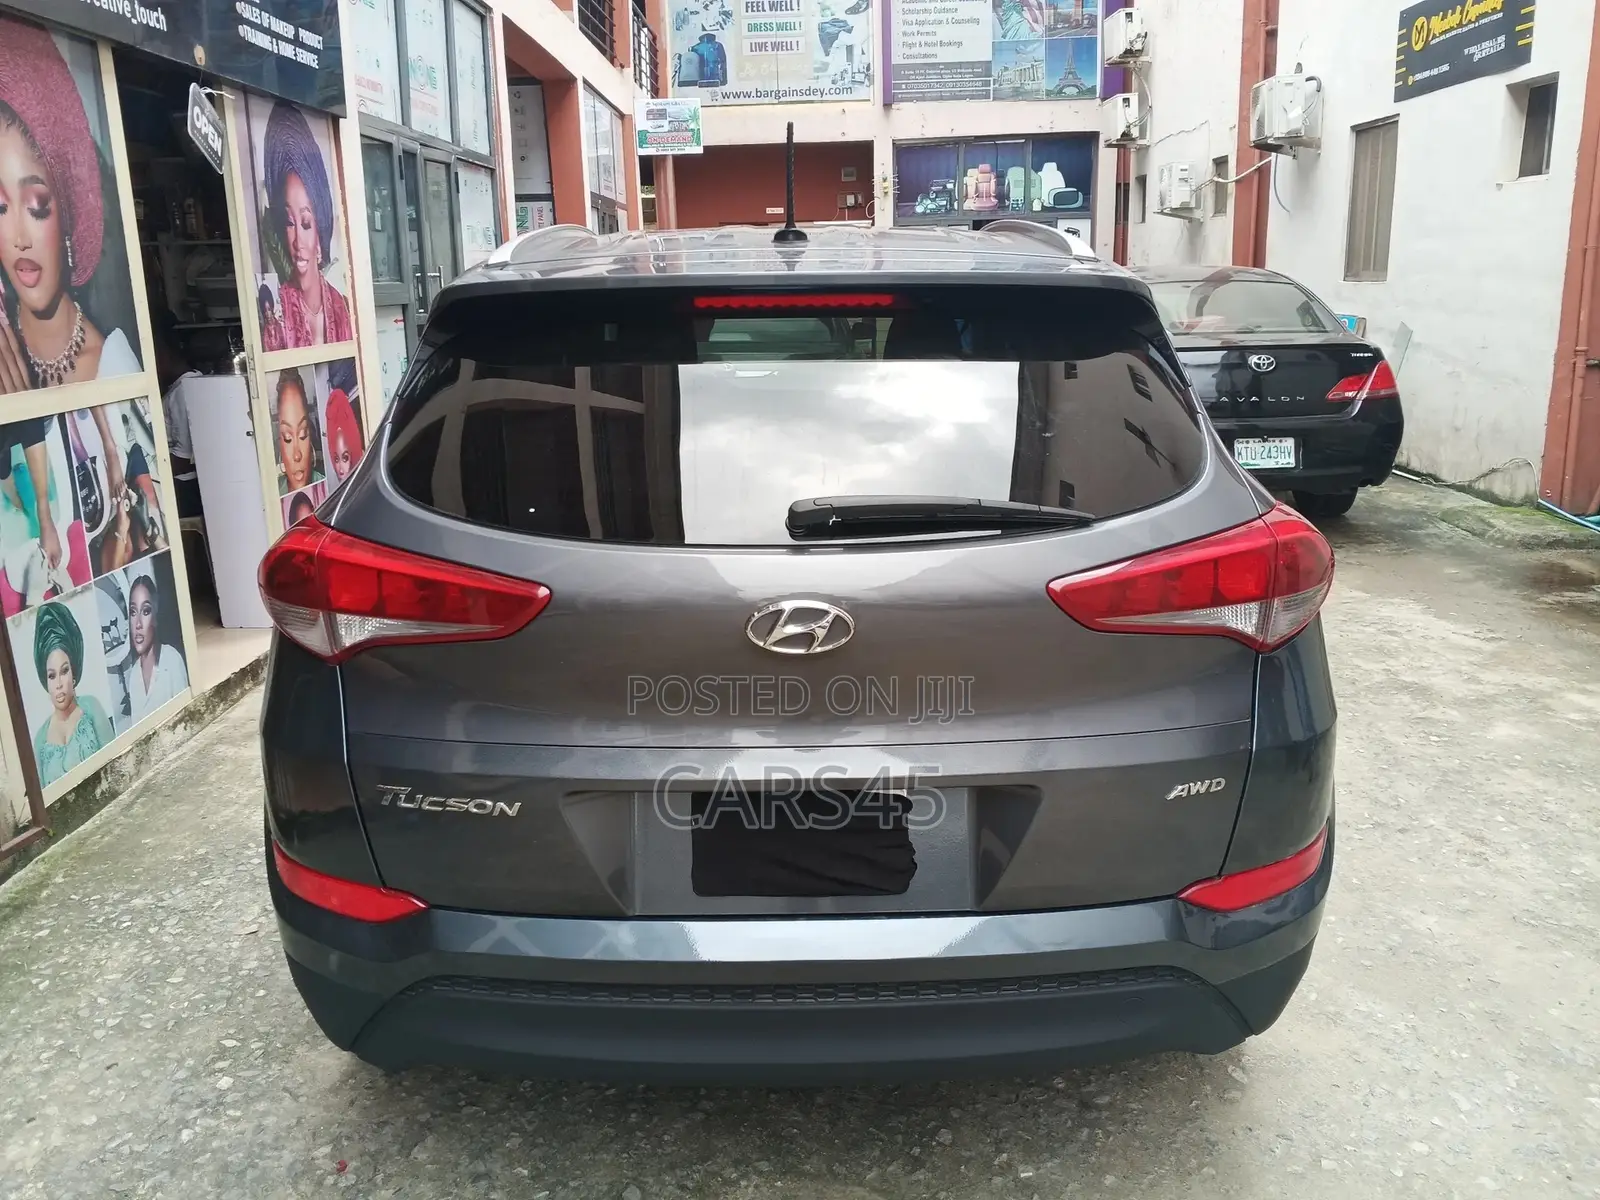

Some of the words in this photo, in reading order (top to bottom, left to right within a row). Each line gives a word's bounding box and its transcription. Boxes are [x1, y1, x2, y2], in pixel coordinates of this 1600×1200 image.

[745, 0, 766, 13] FEEL
[767, 0, 794, 12] WELL
[902, 7, 932, 15] Scholarship
[933, 6, 958, 14] Guidance
[747, 22, 774, 33] DRESS
[775, 21, 798, 32] WELL
[914, 18, 944, 27] Application
[750, 42, 769, 53] LIVE
[770, 41, 794, 52] WELL
[902, 41, 917, 49] Flight
[939, 40, 963, 49] Bookings
[720, 85, 853, 101] www.bargainsdey.com
[193, 105, 222, 157] OPEN
[1164, 777, 1226, 800] AWD
[376, 784, 522, 817] TUCSON
